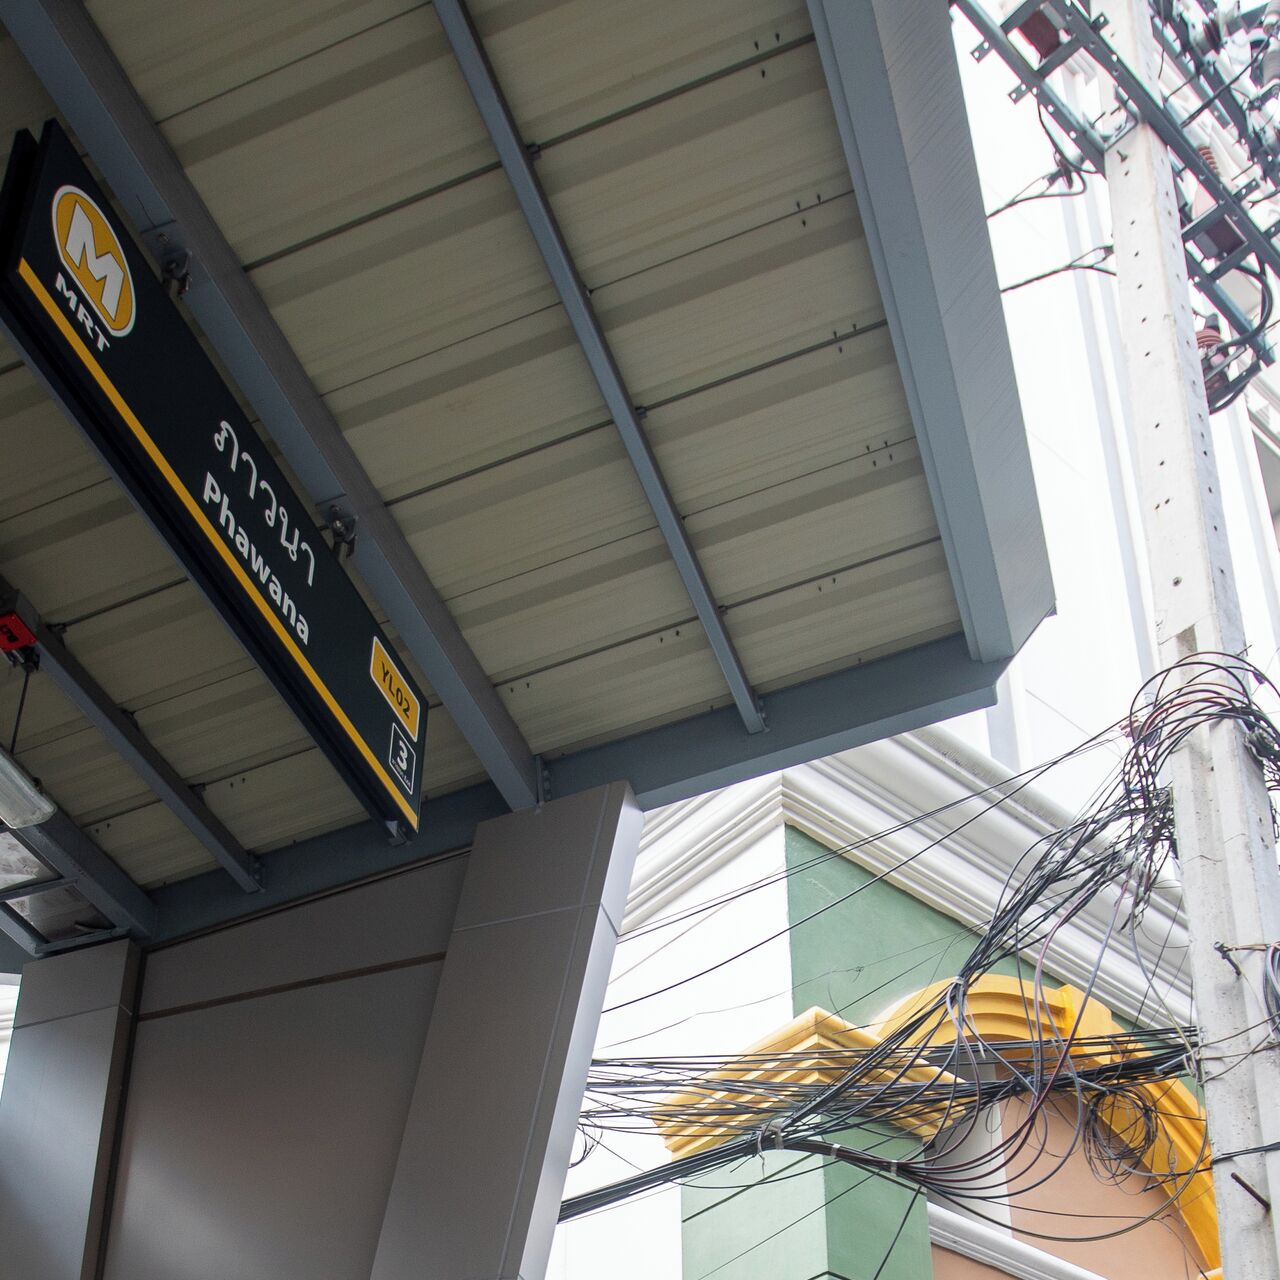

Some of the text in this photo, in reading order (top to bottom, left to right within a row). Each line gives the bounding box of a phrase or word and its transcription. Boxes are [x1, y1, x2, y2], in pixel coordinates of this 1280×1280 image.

[55, 271, 110, 352] MRT
[214, 420, 315, 587] ภาวนา
[203, 471, 309, 646] Phawana
[381, 661, 410, 719] YL02
[397, 740, 408, 771] 3
